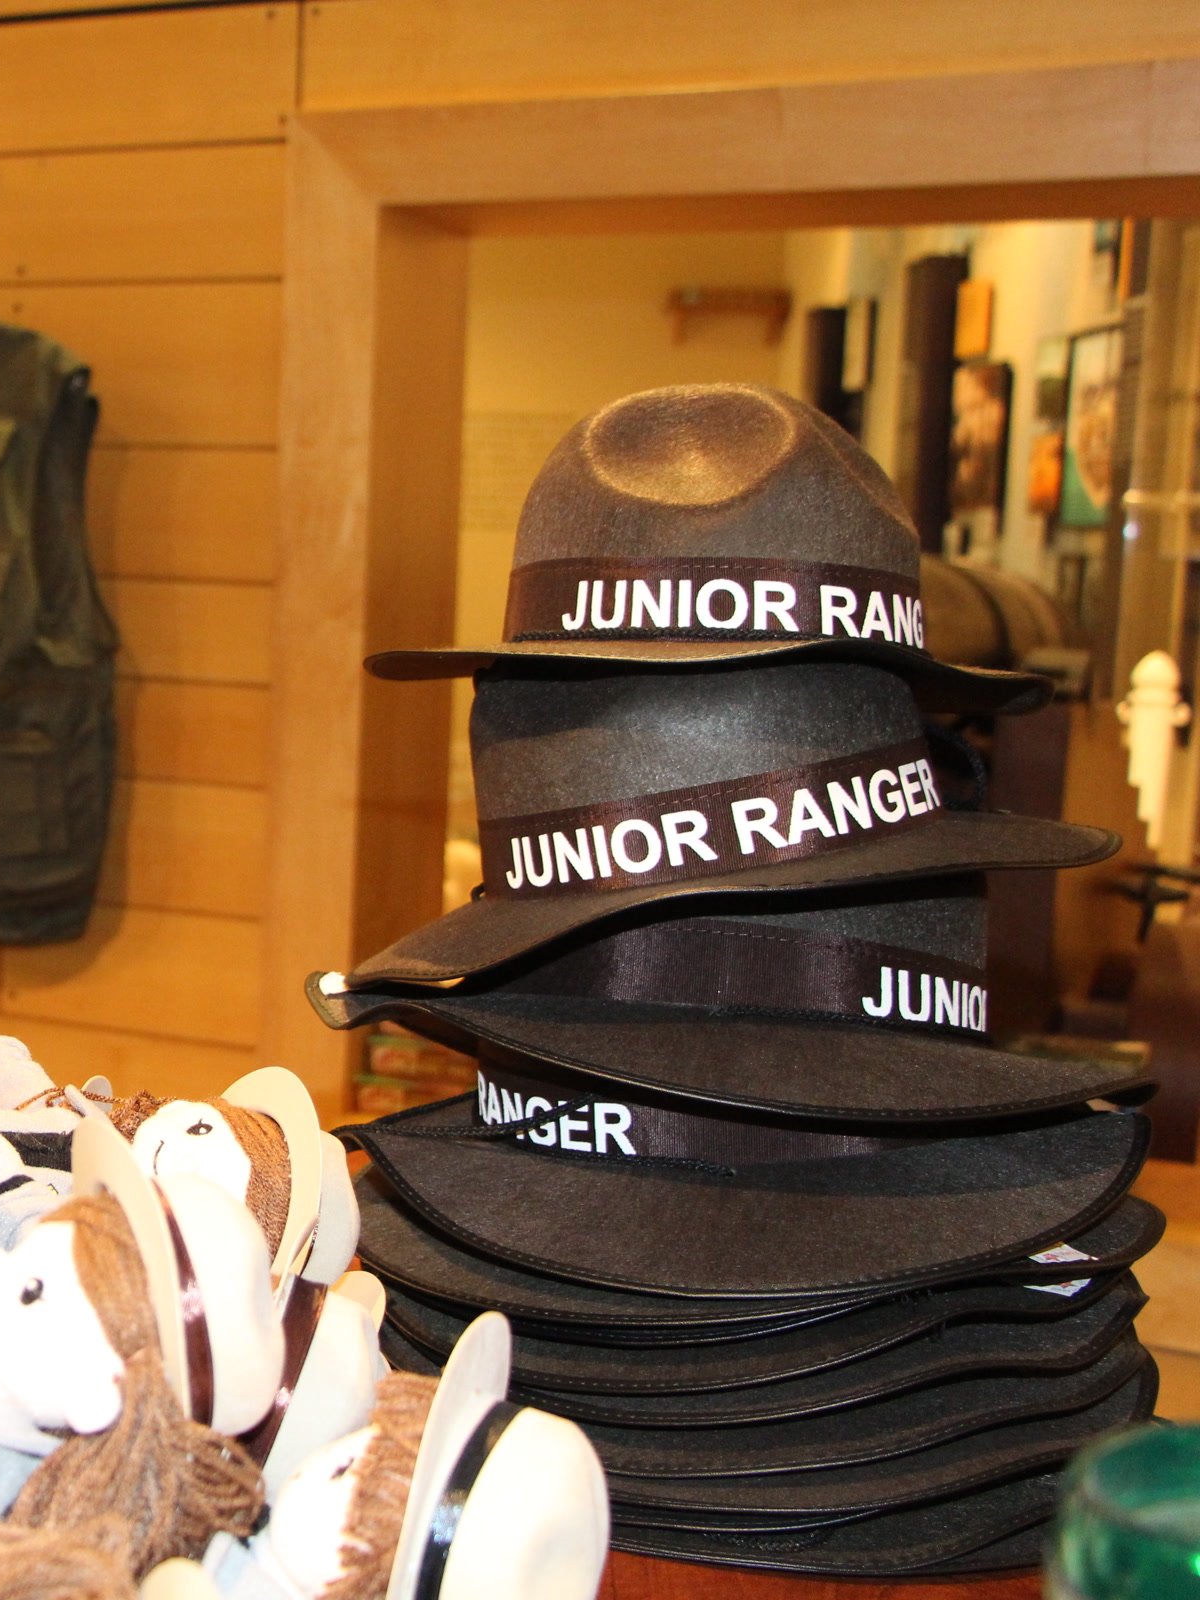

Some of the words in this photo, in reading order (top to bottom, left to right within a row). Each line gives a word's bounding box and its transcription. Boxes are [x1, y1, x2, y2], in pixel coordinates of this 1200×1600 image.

[560, 578, 801, 632] JUNIOR
[505, 809, 719, 890] JUNIOR
[730, 758, 941, 856] RANGER
[477, 1069, 638, 1156] RANGER
